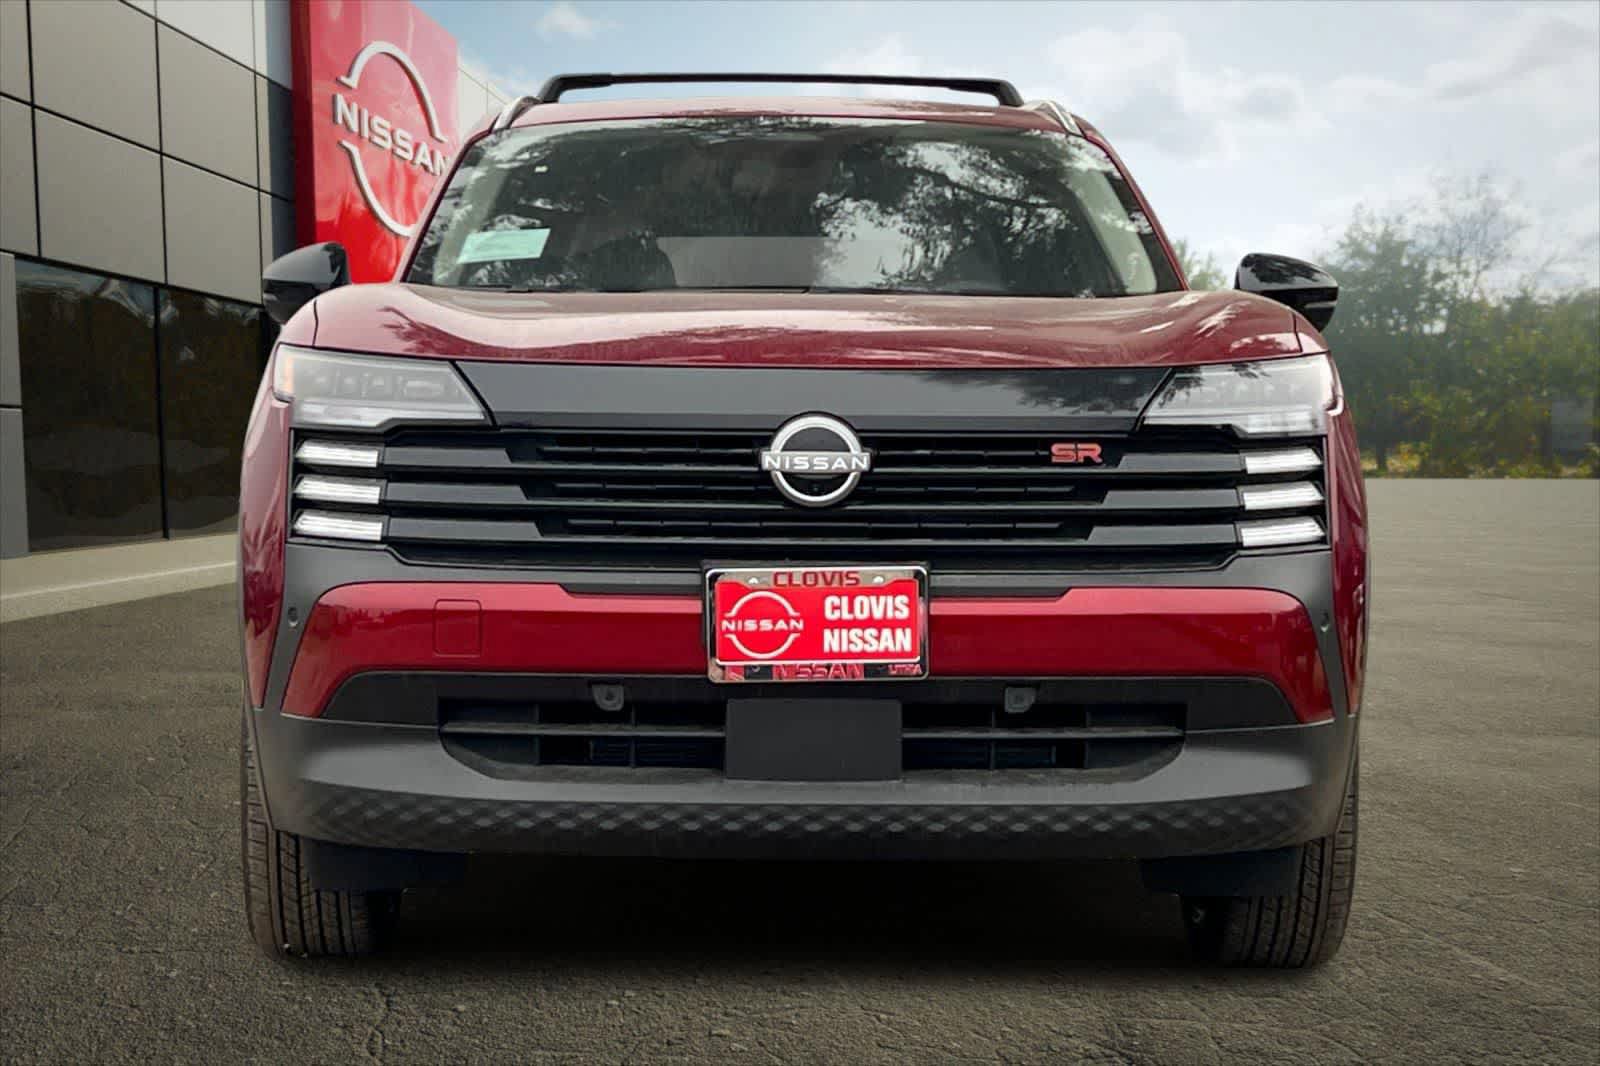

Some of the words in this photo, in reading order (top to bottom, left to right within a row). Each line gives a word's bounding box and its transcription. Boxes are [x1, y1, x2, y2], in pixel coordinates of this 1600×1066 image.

[1051, 443, 1103, 463] SR
[765, 455, 868, 470] NISSAN
[773, 571, 860, 587] CLOVIS
[824, 595, 909, 620] CLOVIS
[721, 619, 804, 632] NISSAN
[823, 628, 912, 653] NISSAN
[772, 664, 864, 680] NISSAN
